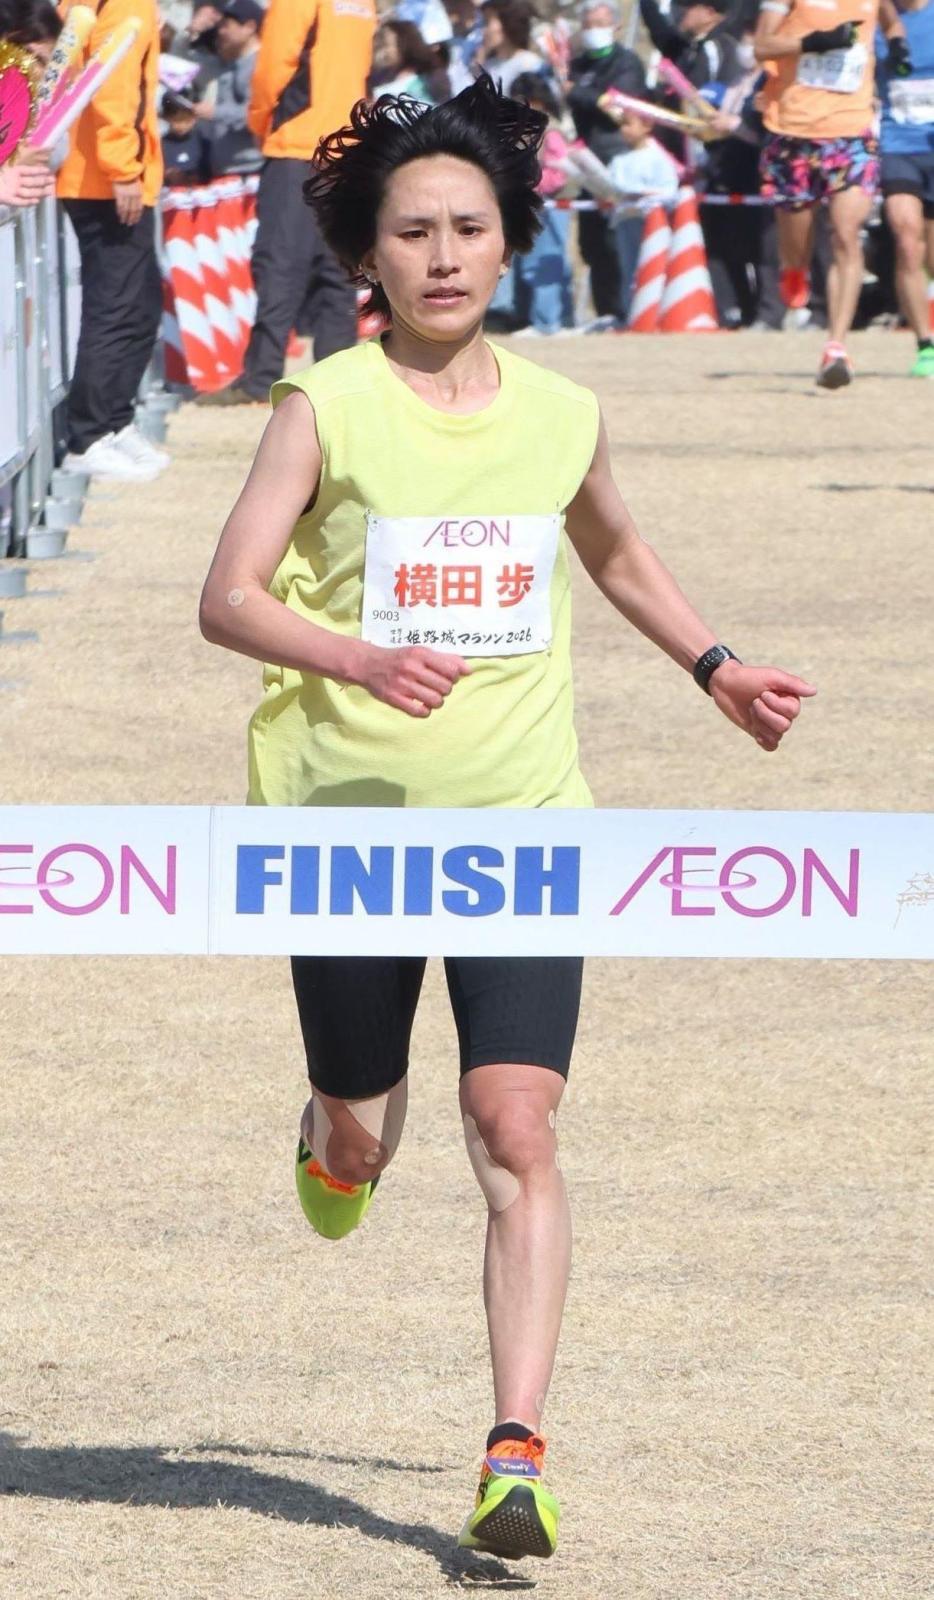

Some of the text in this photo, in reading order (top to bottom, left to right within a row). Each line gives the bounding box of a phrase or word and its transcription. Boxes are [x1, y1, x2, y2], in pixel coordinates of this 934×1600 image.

[394, 563, 535, 608] 横田 歩
[372, 610, 400, 622] 9003
[235, 844, 581, 917] FINISH
